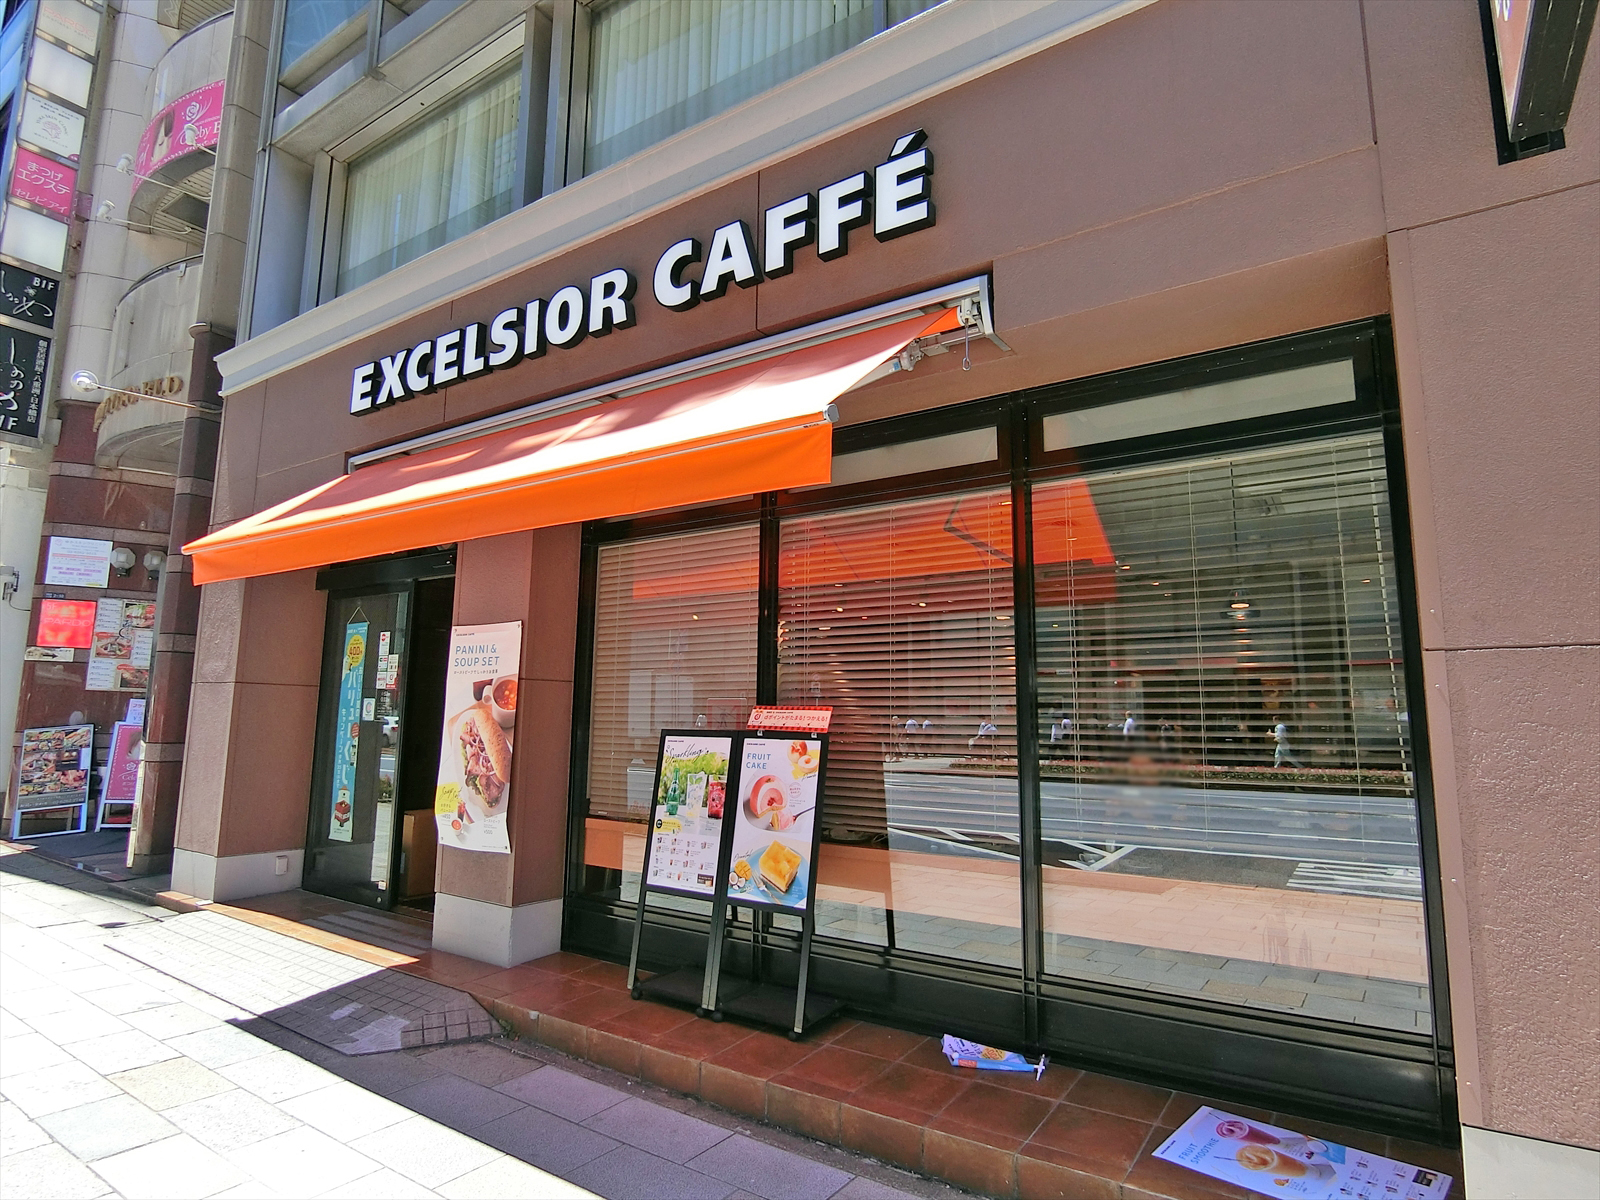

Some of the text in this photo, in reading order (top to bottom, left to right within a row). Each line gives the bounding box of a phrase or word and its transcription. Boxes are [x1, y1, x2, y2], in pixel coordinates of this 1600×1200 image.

[27, 161, 63, 181] まつげ
[17, 168, 71, 194] エクステ
[349, 127, 935, 416] EXCELSIOR CAFFÉ
[43, 617, 92, 627] PARDO
[455, 643, 498, 655] PANINI &
[454, 656, 500, 667] SOUP SET
[746, 752, 772, 761] FRUIT
[745, 761, 768, 770] CAKE
[1178, 1142, 1199, 1161] FRUIT
[1190, 1137, 1220, 1165] SMOOTHIE
